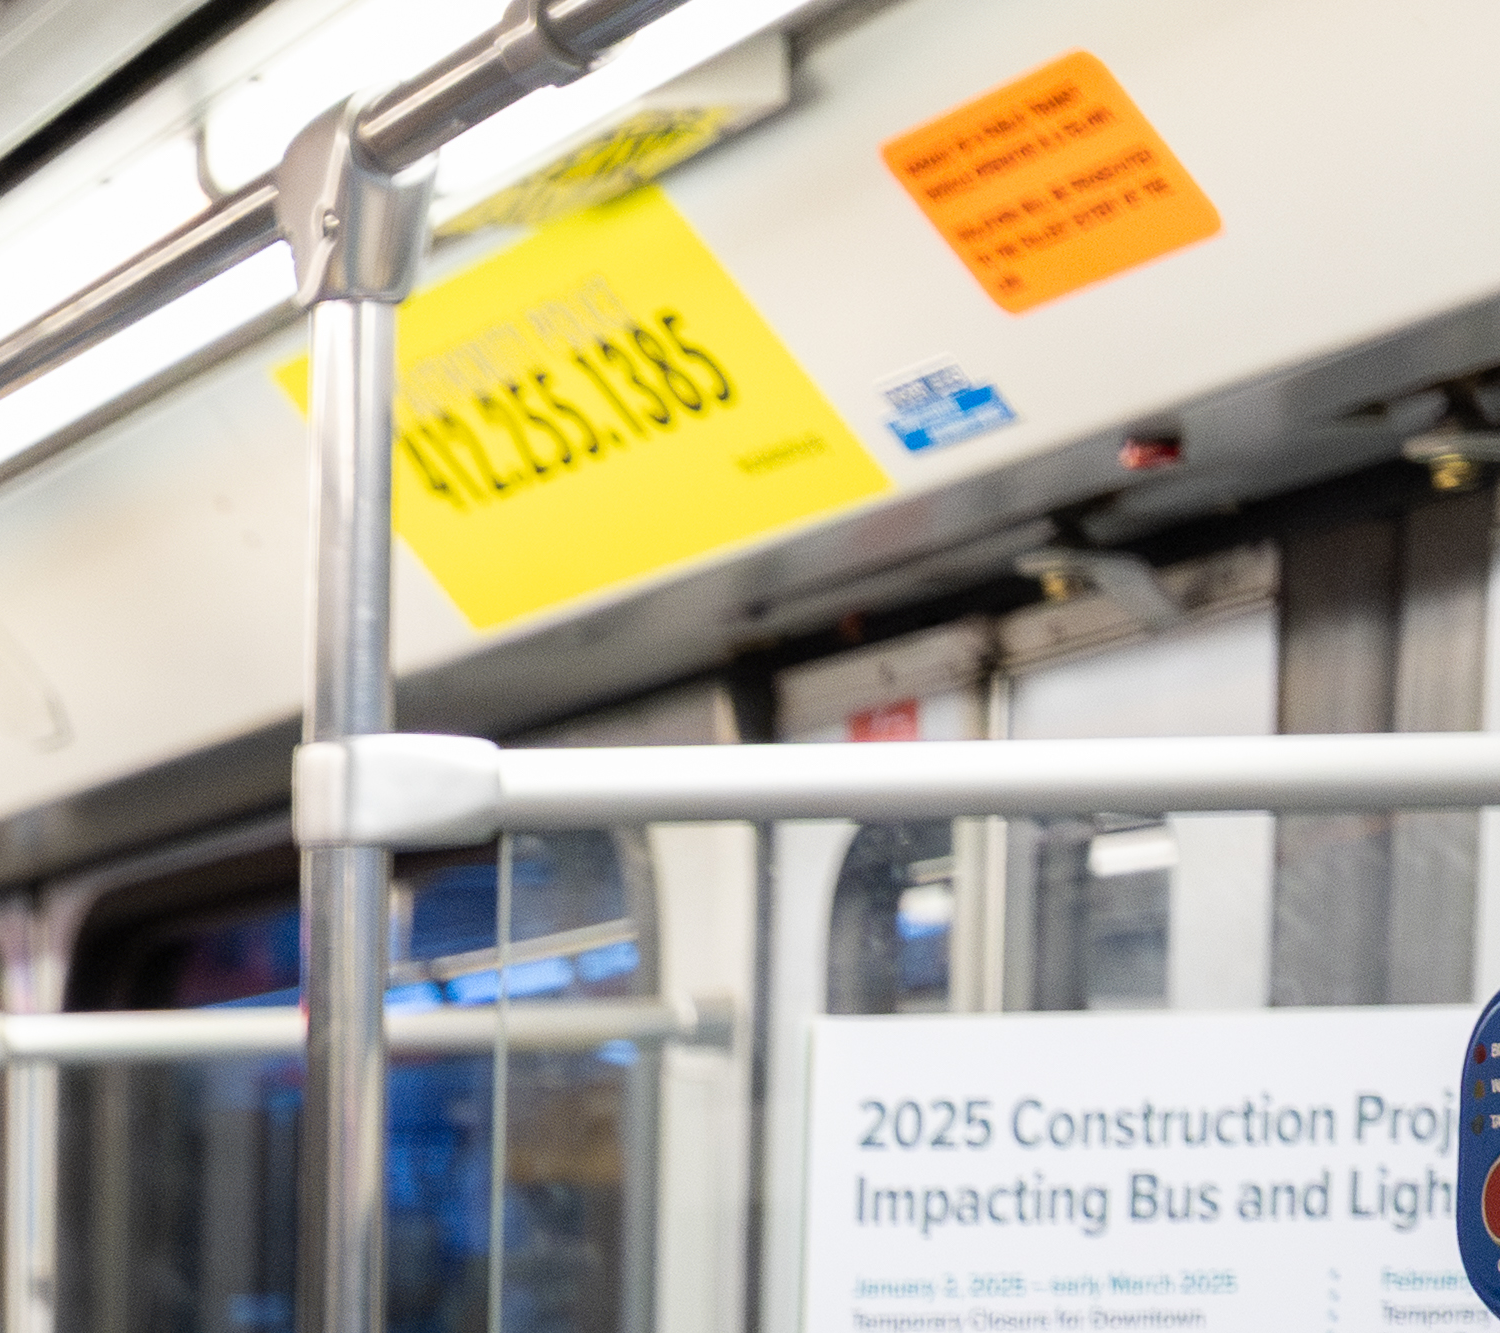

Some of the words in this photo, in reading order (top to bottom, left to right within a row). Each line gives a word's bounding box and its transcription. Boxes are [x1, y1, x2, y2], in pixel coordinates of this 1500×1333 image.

[858, 1098, 994, 1150] 2025
[1011, 1095, 1336, 1148] Construction
[855, 1172, 1109, 1237] Impacting
[1129, 1171, 1221, 1223] Bus
[1238, 1170, 1331, 1221] and
